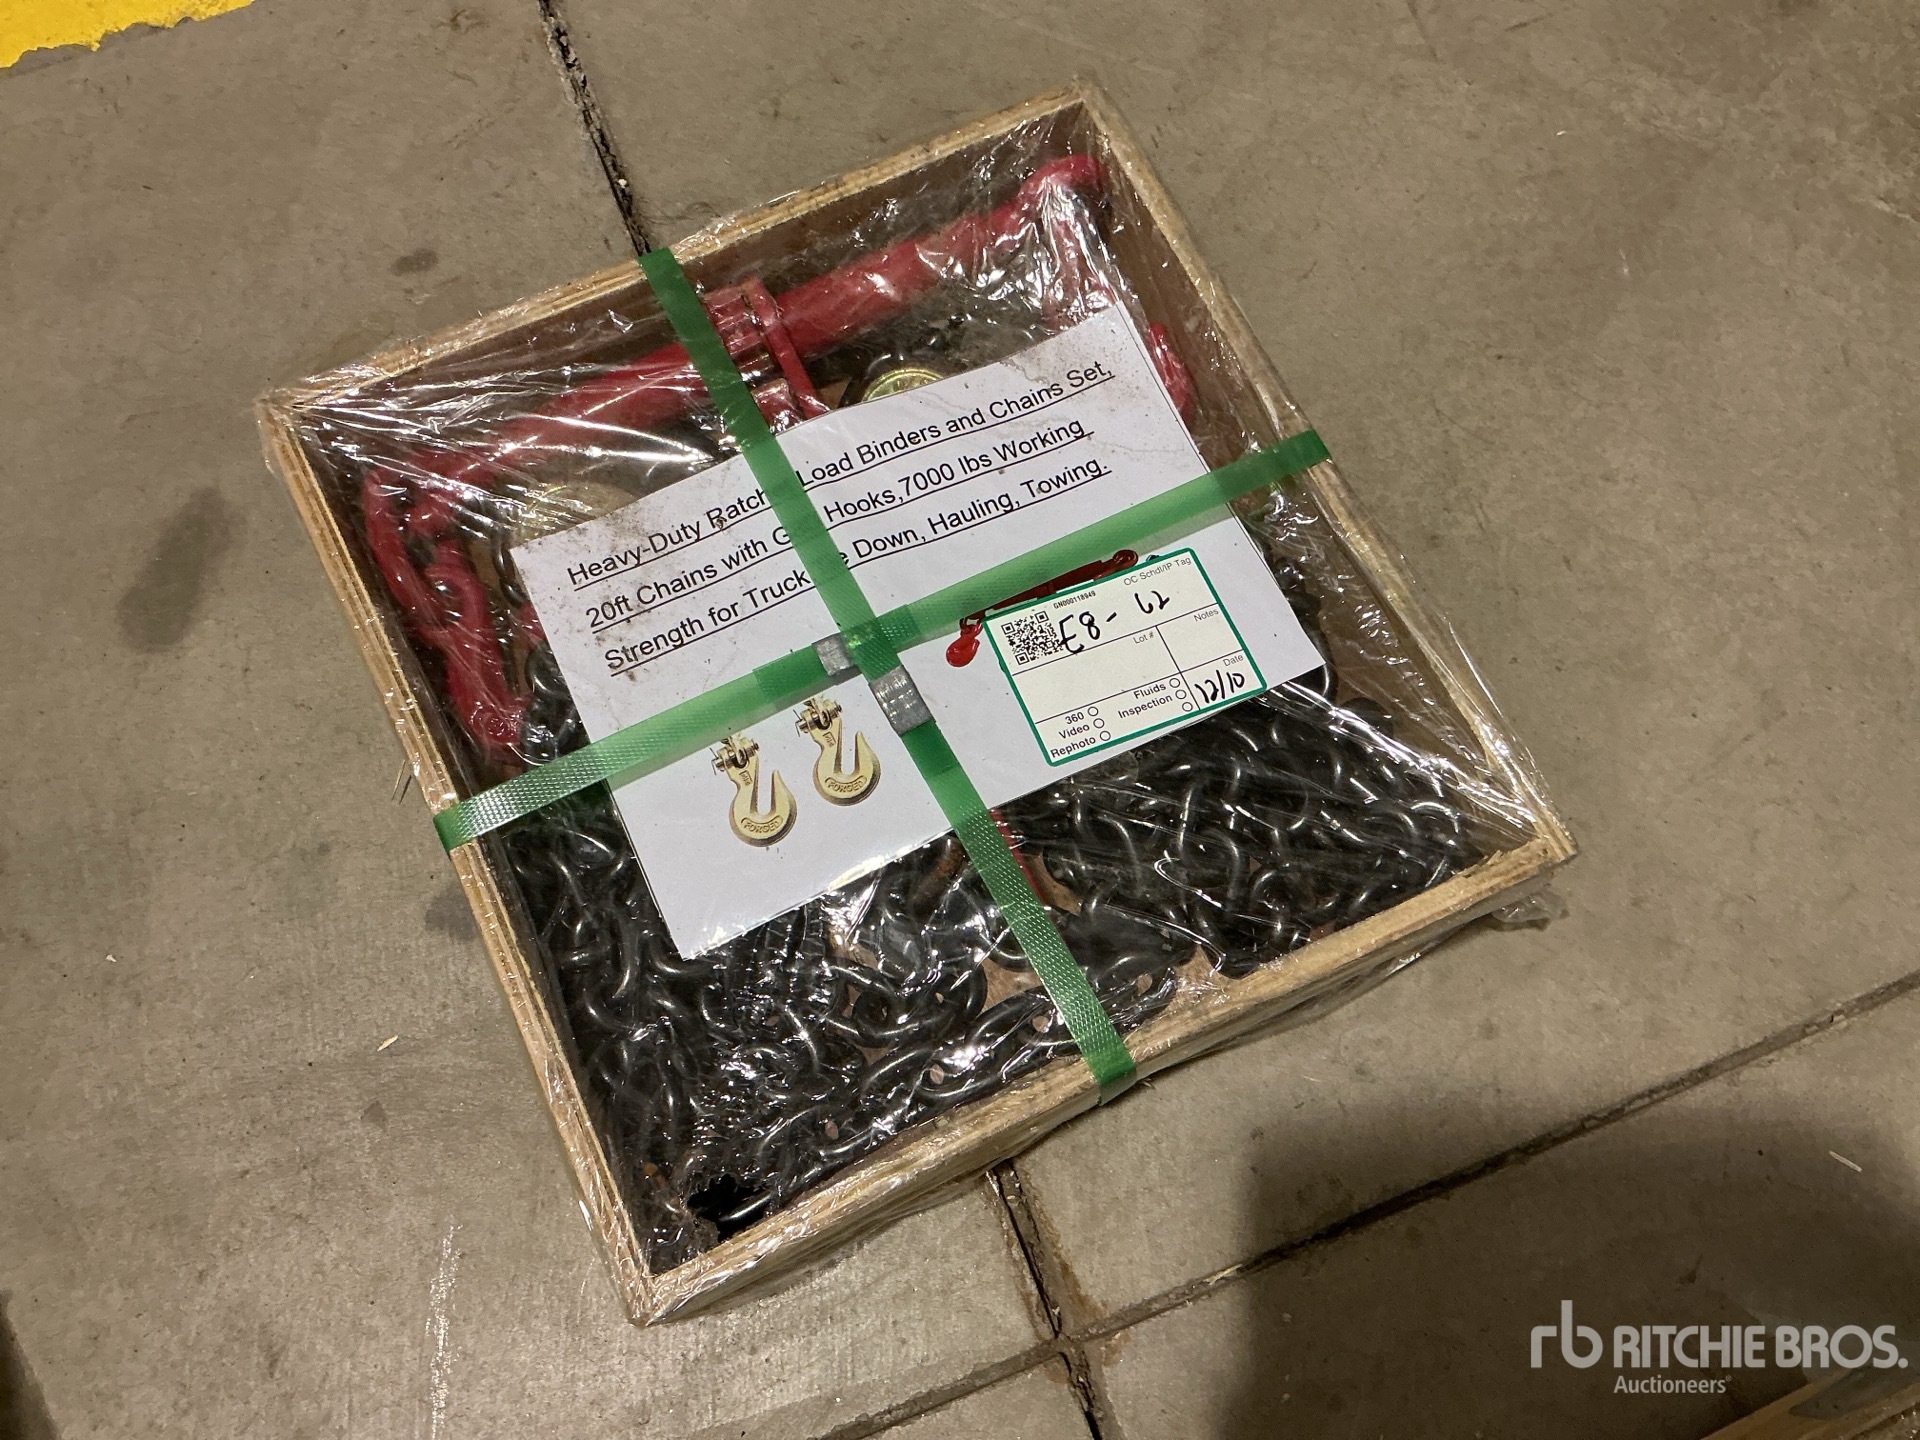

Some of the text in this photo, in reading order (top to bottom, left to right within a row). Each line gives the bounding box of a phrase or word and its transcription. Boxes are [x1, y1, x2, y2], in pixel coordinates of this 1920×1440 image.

[567, 361, 1113, 585] Heavy-Duty Ratch Load Binders and Chains Set,
[585, 591, 633, 629] 20ft
[636, 563, 718, 606] Chains
[721, 537, 768, 571] with
[958, 452, 992, 476] lbs
[992, 418, 1086, 463] Working
[604, 457, 1107, 669] Strength for Truck Down, Hauling, Towing.
[1123, 574, 1139, 586] OC
[1174, 556, 1192, 570] Tag
[1193, 607, 1219, 623] Notes
[1133, 631, 1155, 645] Lot #
[1222, 654, 1244, 667] Date
[1133, 682, 1167, 700] Fluids
[1117, 693, 1173, 720] Inspection
[1065, 712, 1085, 725] 360
[1058, 723, 1090, 740] Video
[1050, 735, 1097, 759] Rephoto
